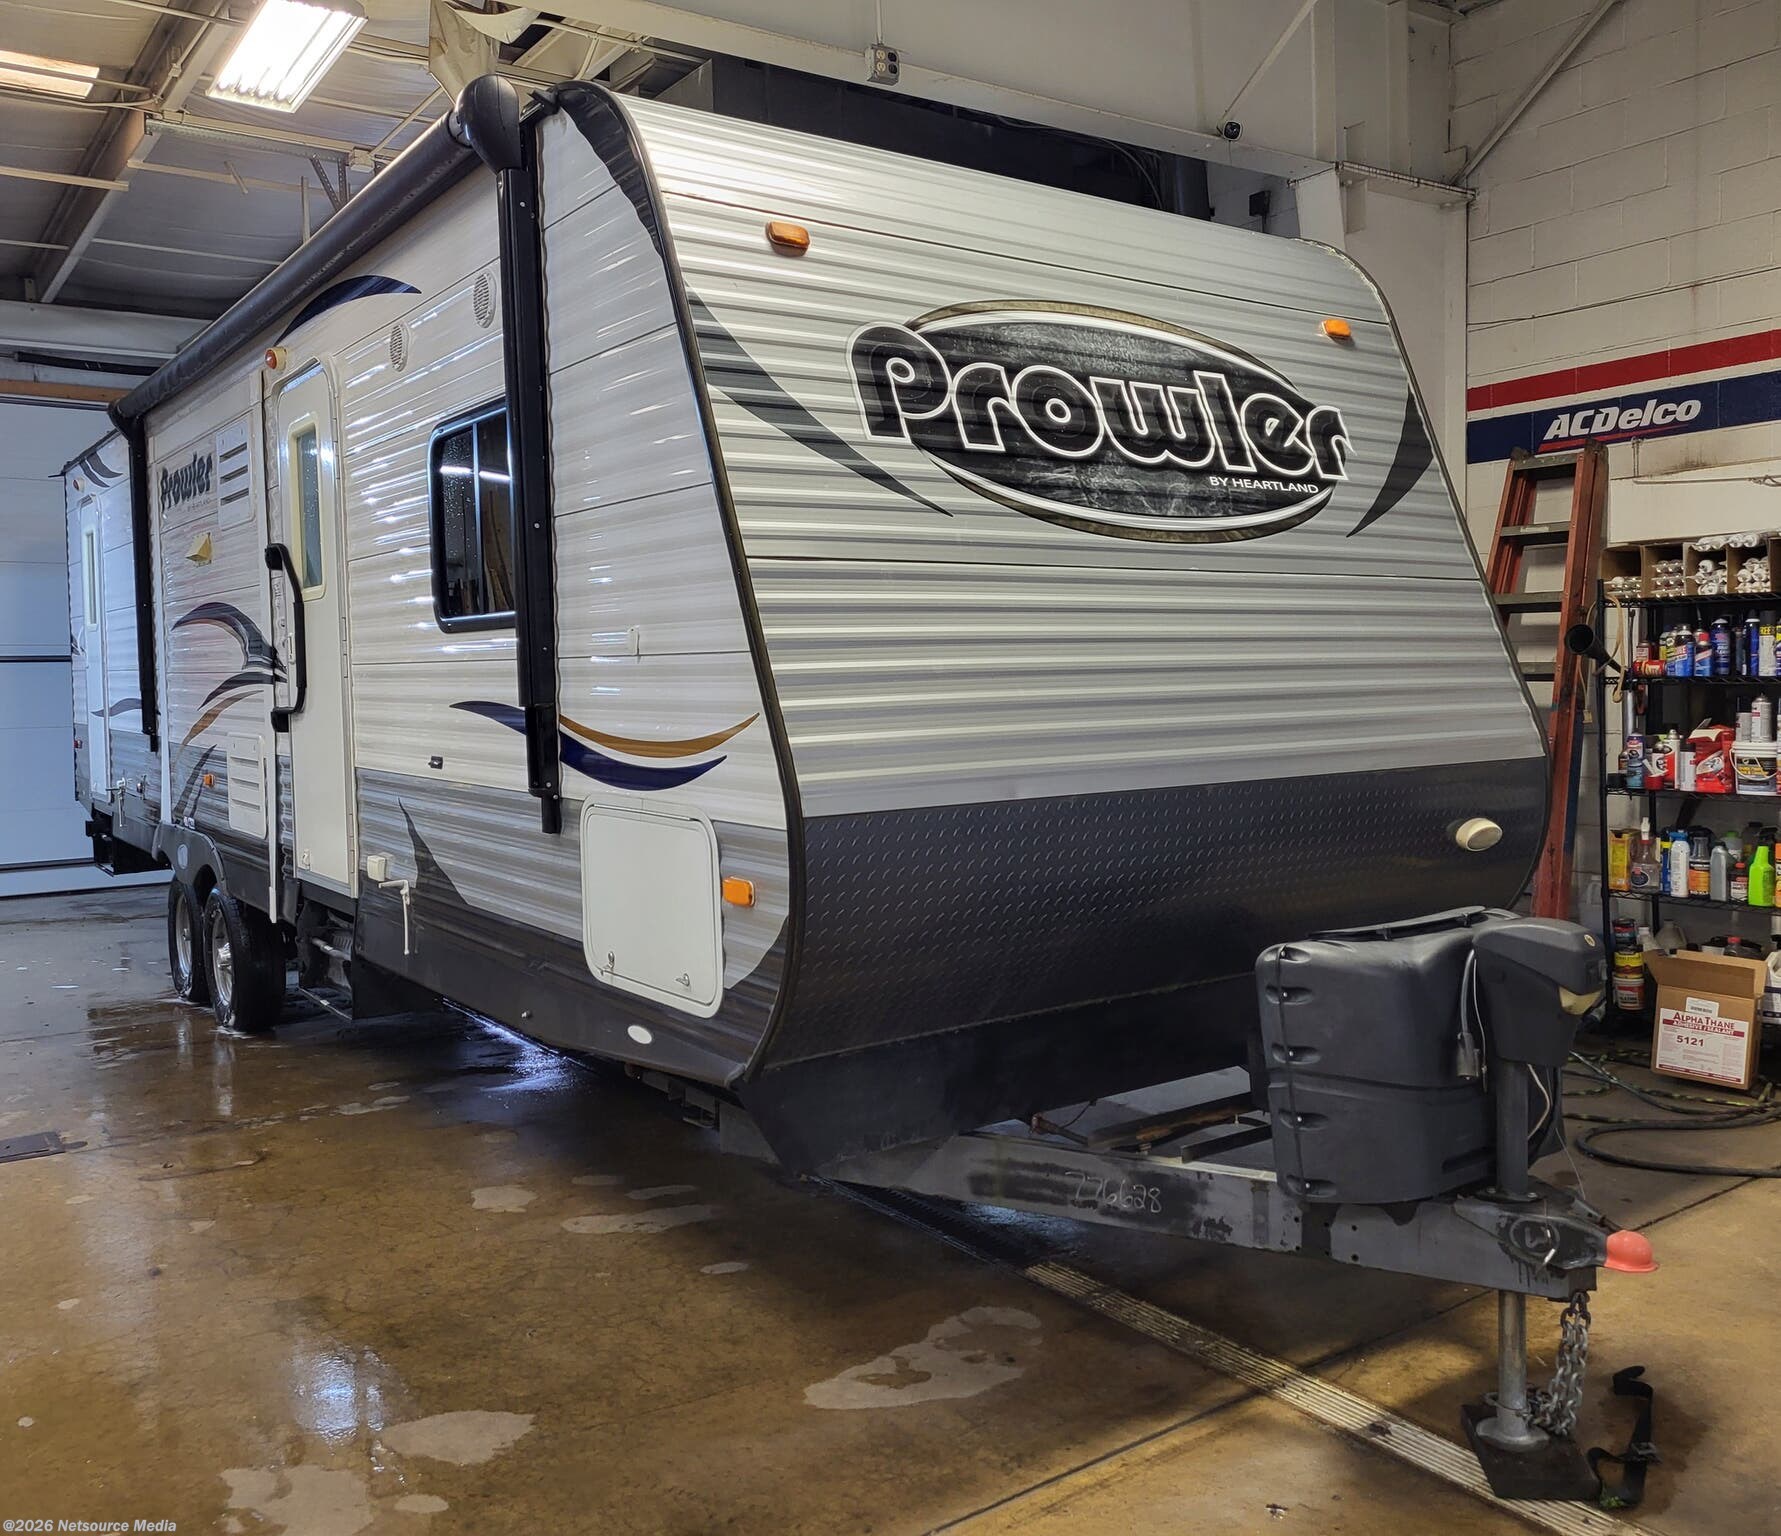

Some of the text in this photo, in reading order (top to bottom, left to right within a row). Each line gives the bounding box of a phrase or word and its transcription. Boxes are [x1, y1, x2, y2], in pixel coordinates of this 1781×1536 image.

[848, 322, 1352, 481] Prowler
[1543, 399, 1701, 440] ACDelco
[161, 451, 212, 513] Prowler
[1209, 476, 1319, 494] BY HEARTLAND
[1676, 1035, 1705, 1047] 5121
